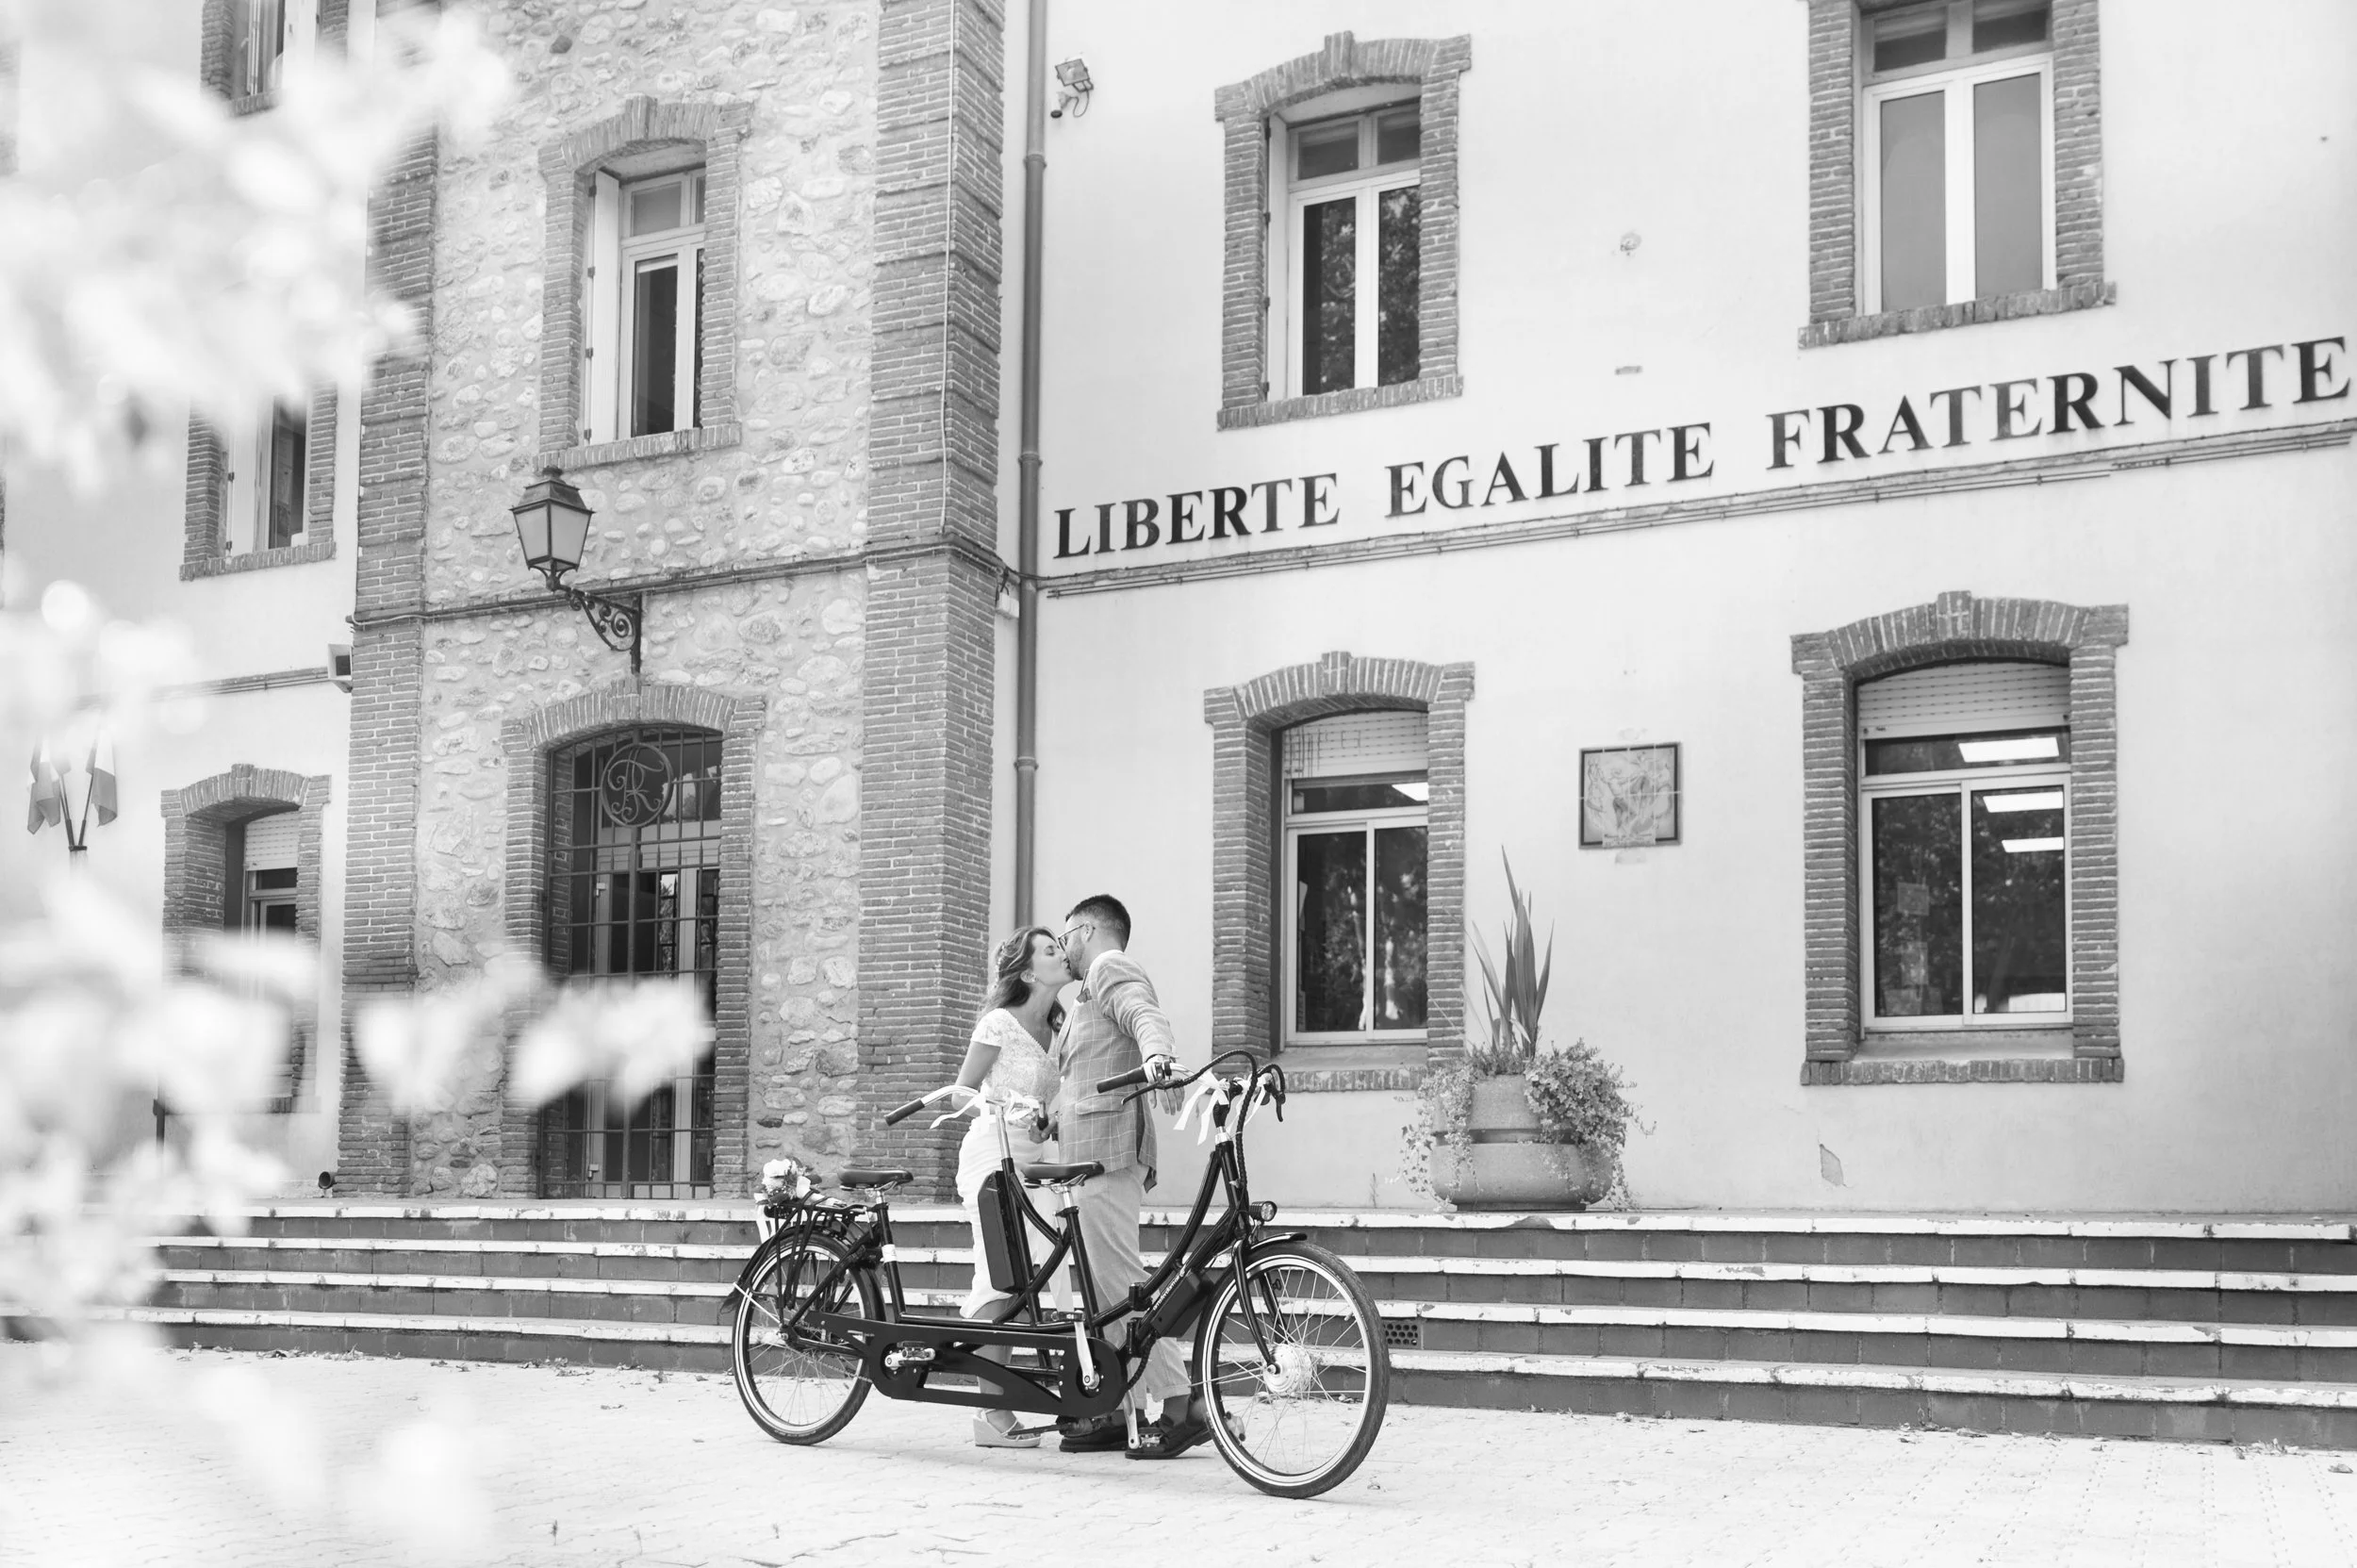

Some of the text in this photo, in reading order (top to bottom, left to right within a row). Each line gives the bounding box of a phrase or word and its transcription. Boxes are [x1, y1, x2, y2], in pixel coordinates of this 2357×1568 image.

[1053, 336, 2351, 559] LIBERTE EGALITE FRATERNITE
